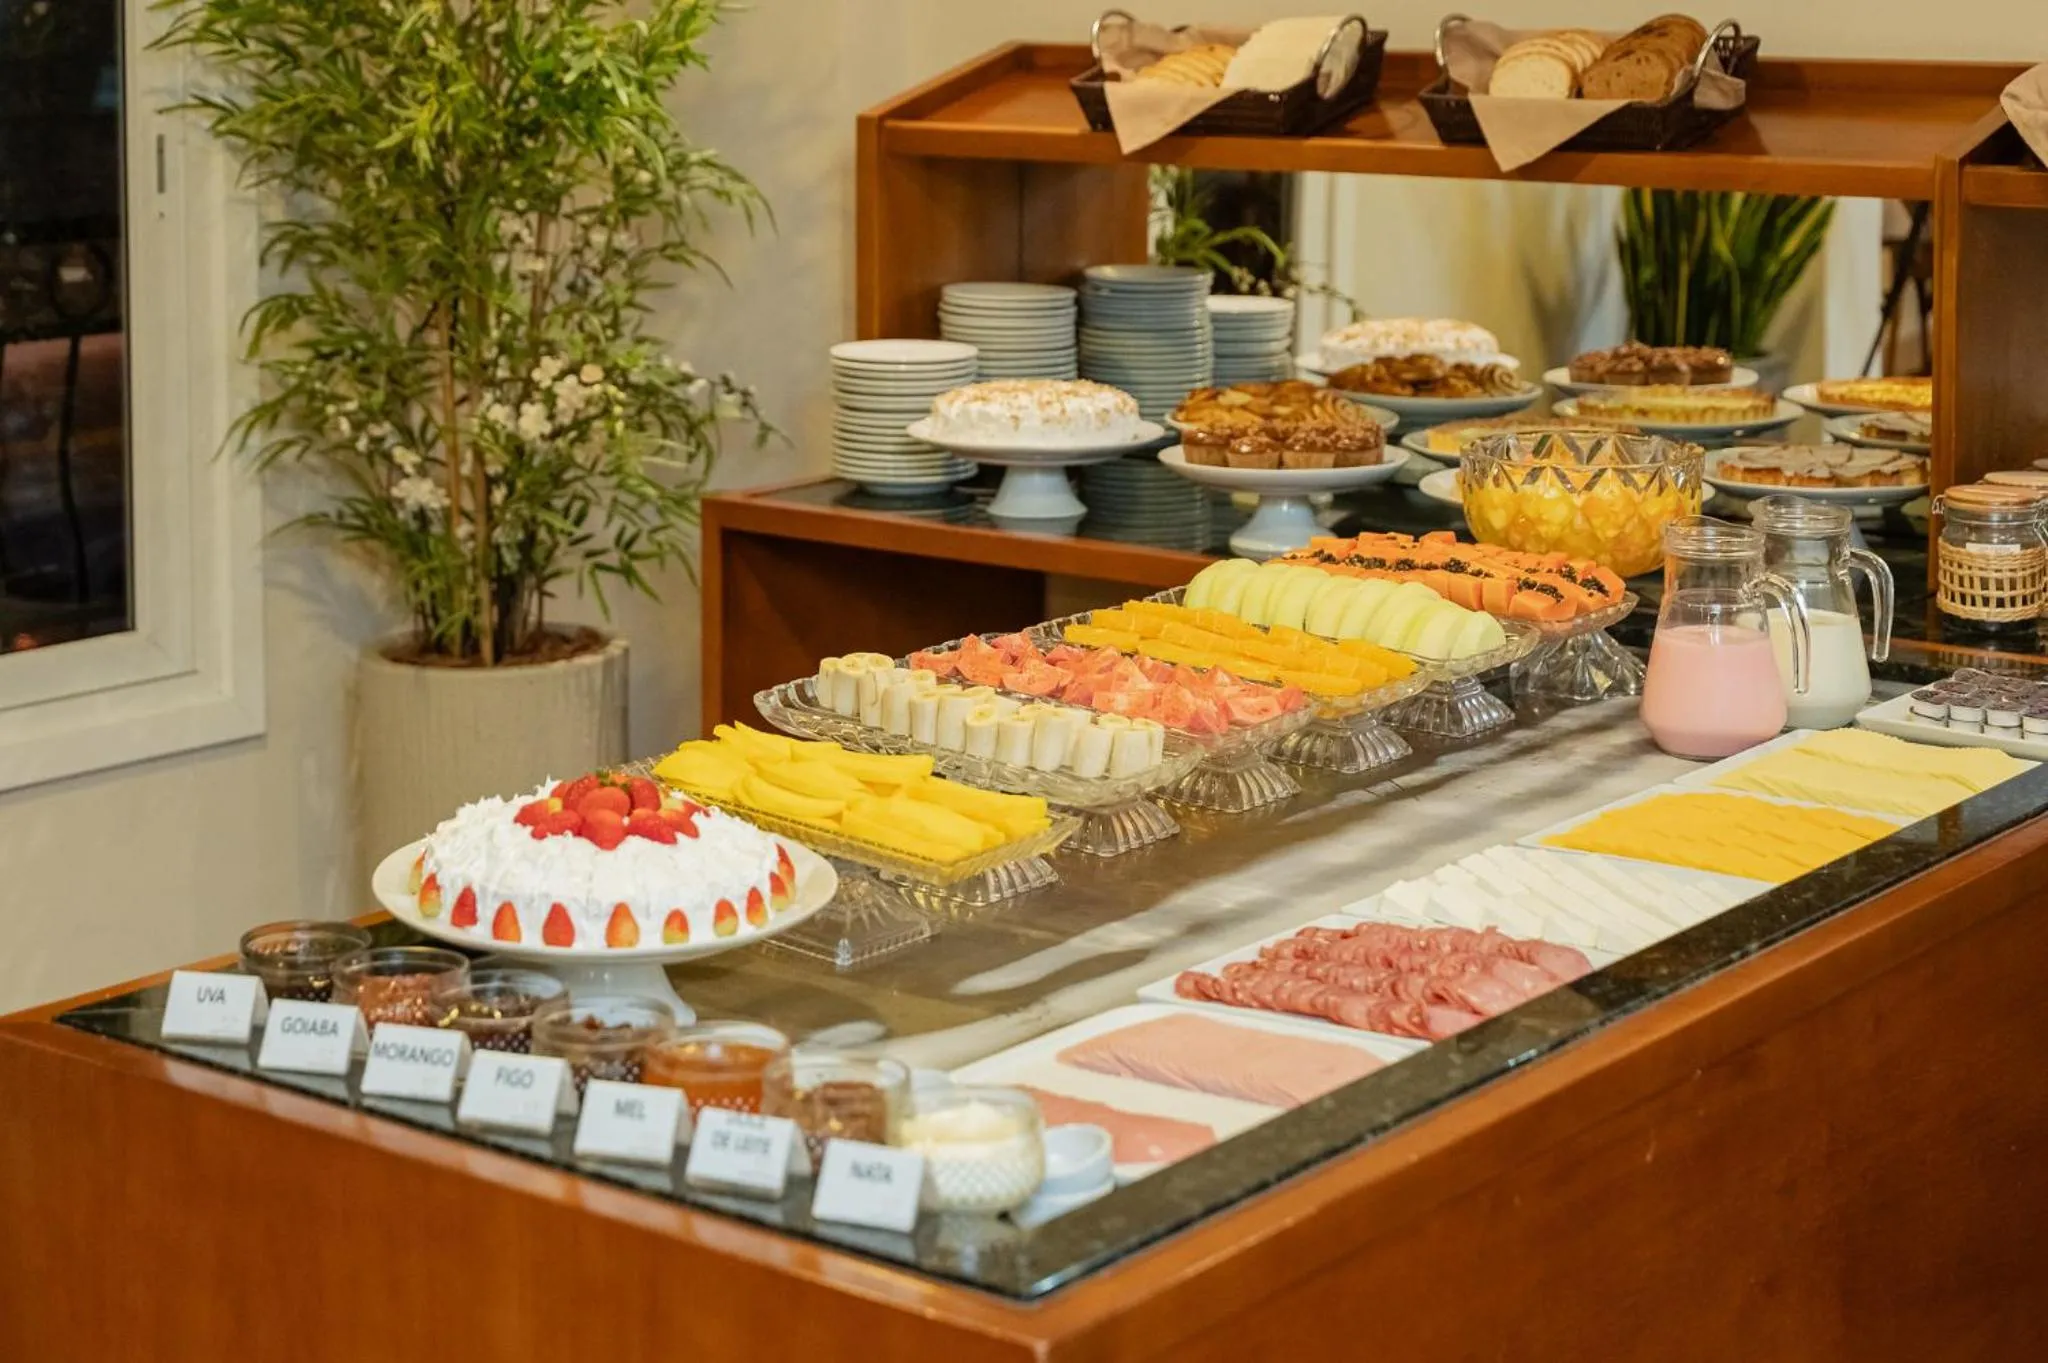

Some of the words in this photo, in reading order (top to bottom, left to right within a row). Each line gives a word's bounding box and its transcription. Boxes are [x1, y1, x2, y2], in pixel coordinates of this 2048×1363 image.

[196, 986, 227, 1004] UVA
[281, 1016, 339, 1038] GOIABA
[373, 1041, 456, 1067] MORANGO
[494, 1065, 535, 1089] FIGO
[614, 1098, 646, 1121] MEL
[850, 1159, 894, 1185] NATA
